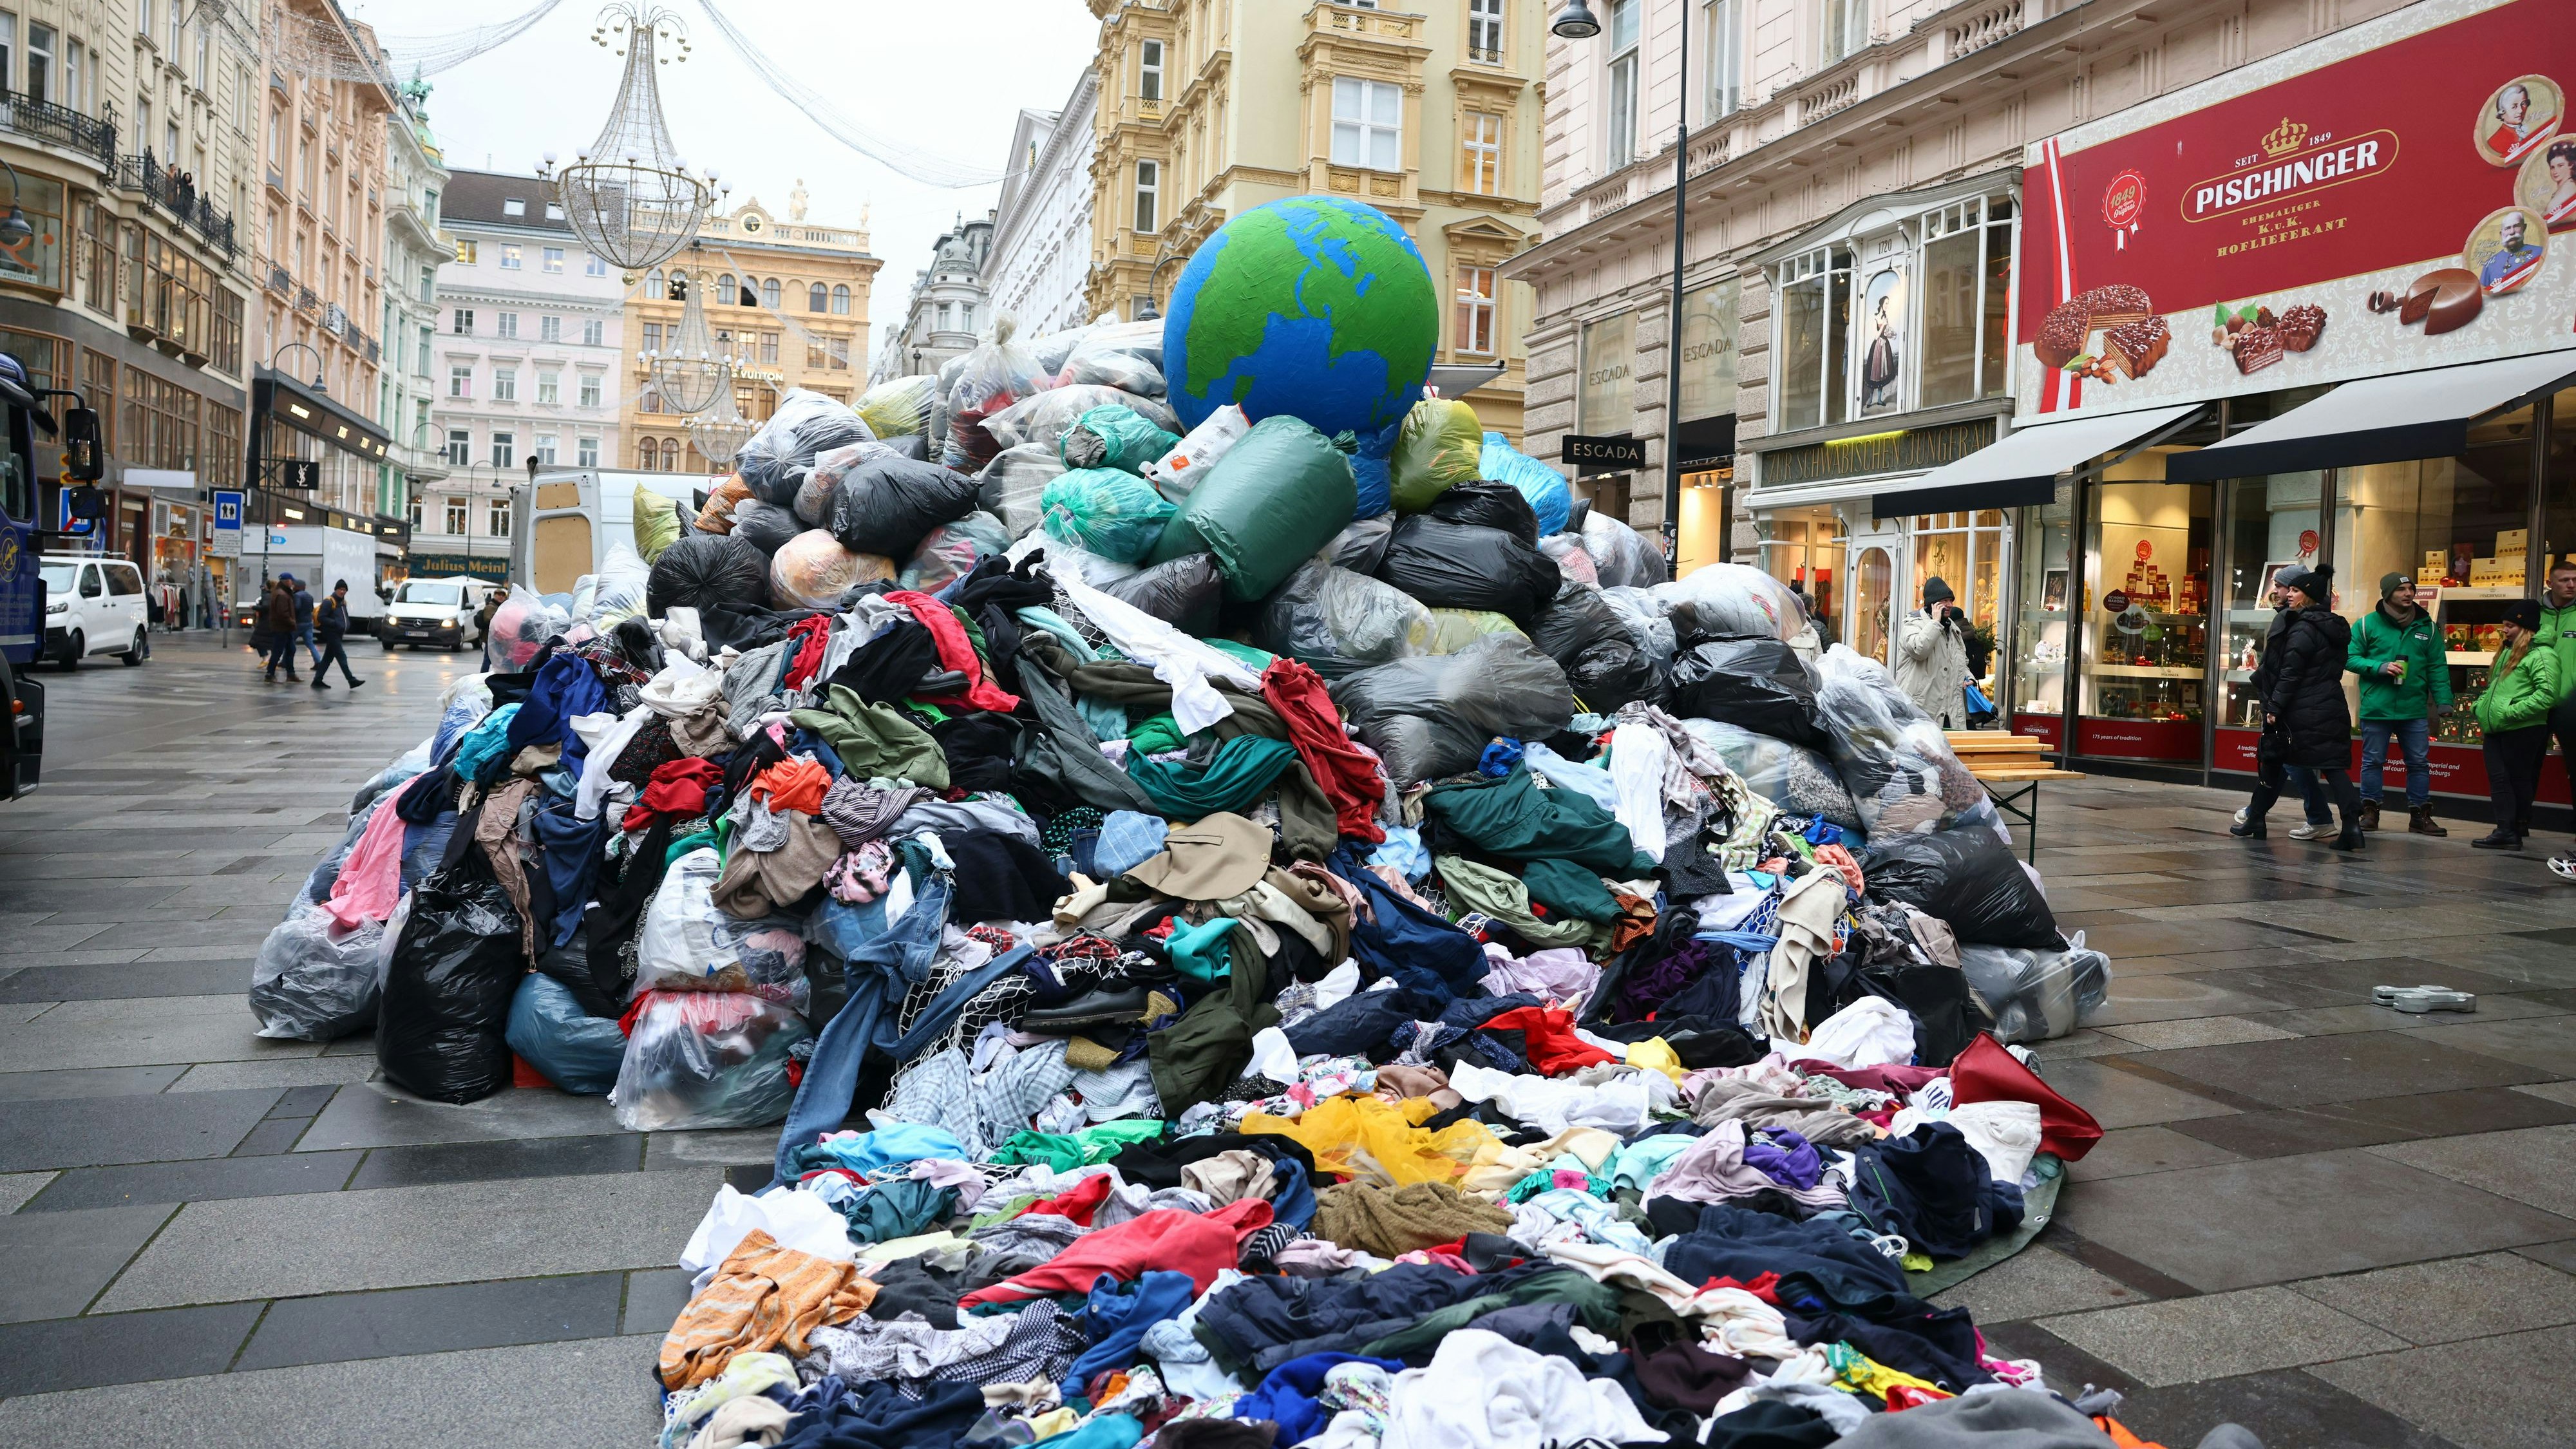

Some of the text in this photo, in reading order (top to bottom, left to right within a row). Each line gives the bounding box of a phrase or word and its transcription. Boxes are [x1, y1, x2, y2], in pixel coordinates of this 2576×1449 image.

[2235, 131, 2331, 167] SEIT 1849
[2196, 140, 2379, 214] PISCHINGER
[2110, 185, 2136, 209] 1849
[2114, 201, 2136, 218] Original
[2241, 200, 2321, 226] EHEMALIGER
[1878, 238, 1892, 254] 1720
[2216, 217, 2347, 258] HOFLIEFERANT
[1683, 336, 1734, 363] ESCADA
[741, 370, 784, 382] VUITTON
[1589, 363, 1630, 386] ESCADA
[1573, 443, 1639, 460] ESCADA
[1796, 435, 1901, 480] SCHWÄBISCHEN
[422, 559, 507, 574] Julius Meinl
[2429, 770, 2451, 778] bsburgs
